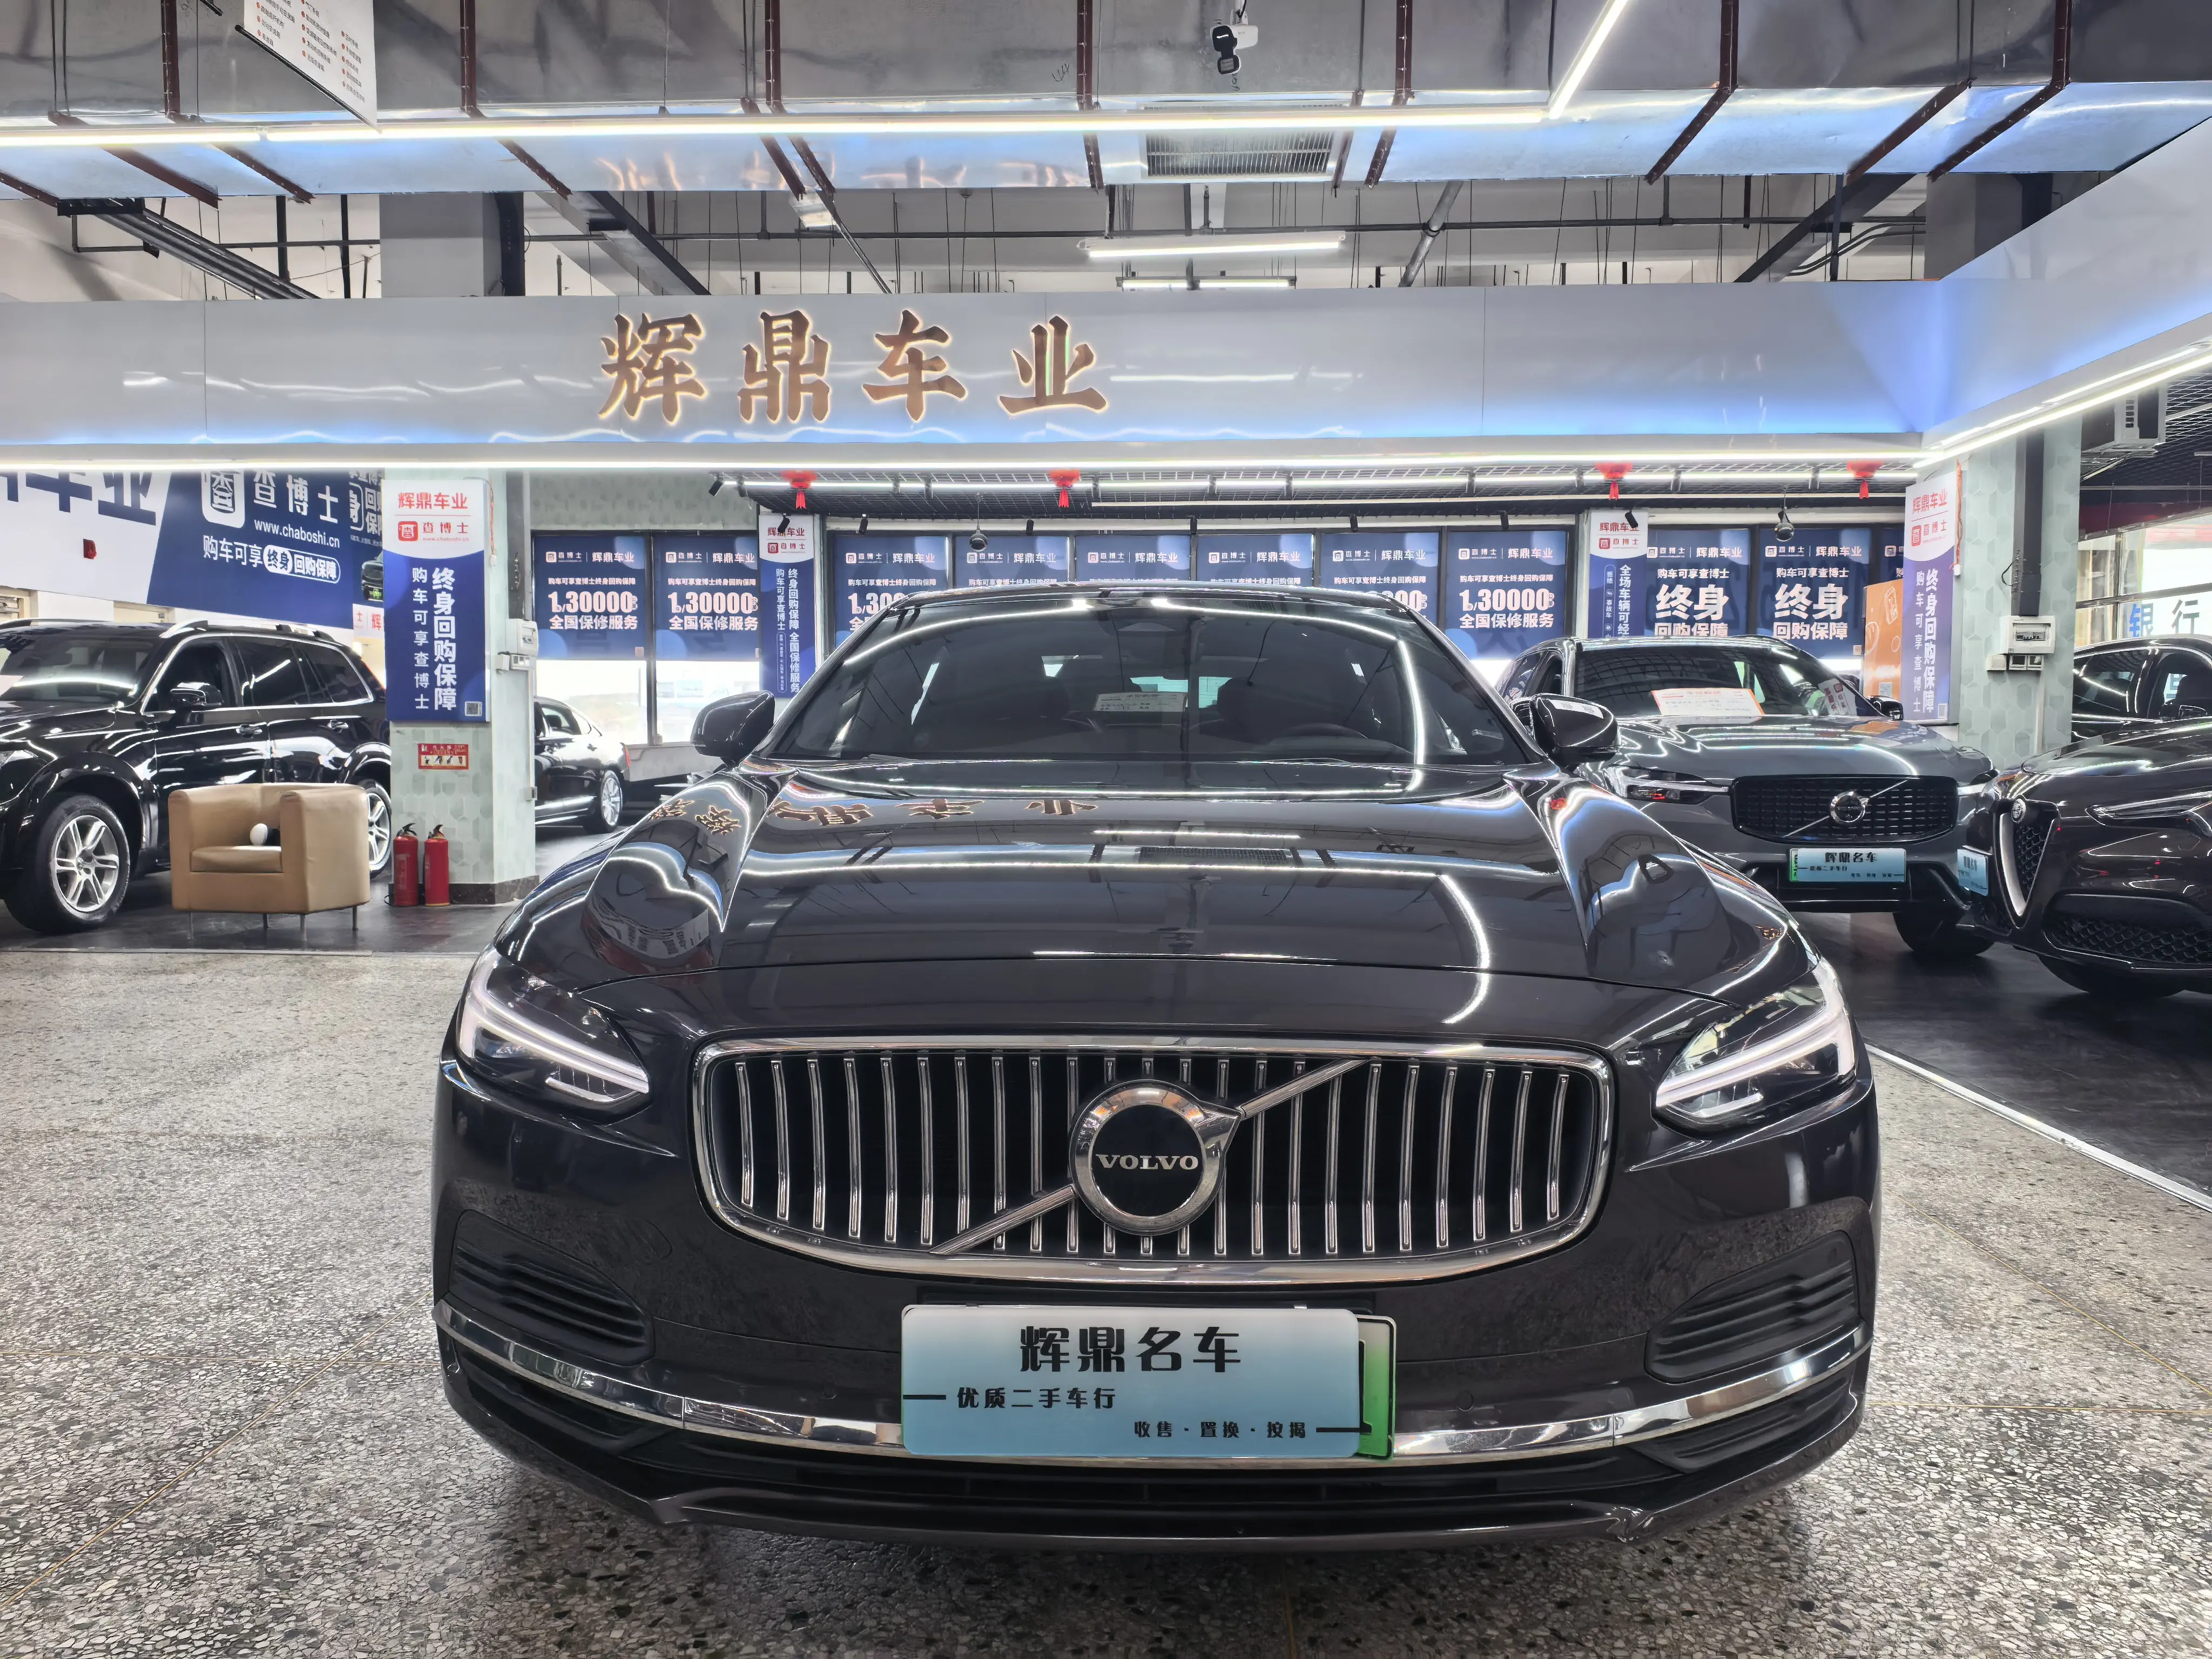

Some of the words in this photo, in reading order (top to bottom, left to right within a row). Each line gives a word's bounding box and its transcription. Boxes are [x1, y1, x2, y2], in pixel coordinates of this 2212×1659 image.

[599, 310, 1108, 423] 辉鼎车业
[398, 492, 468, 509] 辉鼎车业
[1912, 488, 1947, 514] 辉鼎车业
[254, 519, 340, 548] www.chaboshi.cn
[1381, 549, 1426, 561] 辉鼎车业
[1508, 548, 1553, 558] 辉鼎车业
[1696, 547, 1742, 558] 辉鼎车业
[1816, 546, 1862, 557] 辉鼎车业
[1657, 569, 1729, 578] 购车可享查博士
[1776, 568, 1849, 578] 购车可享查博士
[1655, 584, 1729, 621] 终身
[1775, 583, 1849, 619] 终身
[549, 615, 638, 630] 全国保修服务
[669, 615, 758, 631] 全国保修服务
[1460, 613, 1554, 628] 全国保修服务
[1655, 622, 1728, 637] 回购保障
[1773, 622, 1848, 640] 回购保障
[412, 567, 429, 710] 购车可享查博士
[432, 567, 456, 711] 终身回购保障
[1923, 569, 1938, 713] 终身回购保障
[790, 632, 800, 692] 全国保修服务
[1096, 1154, 1198, 1170] VOLVO
[1020, 1326, 1241, 1373] 辉鼎名车
[957, 1387, 1116, 1409] 优质二手车行
